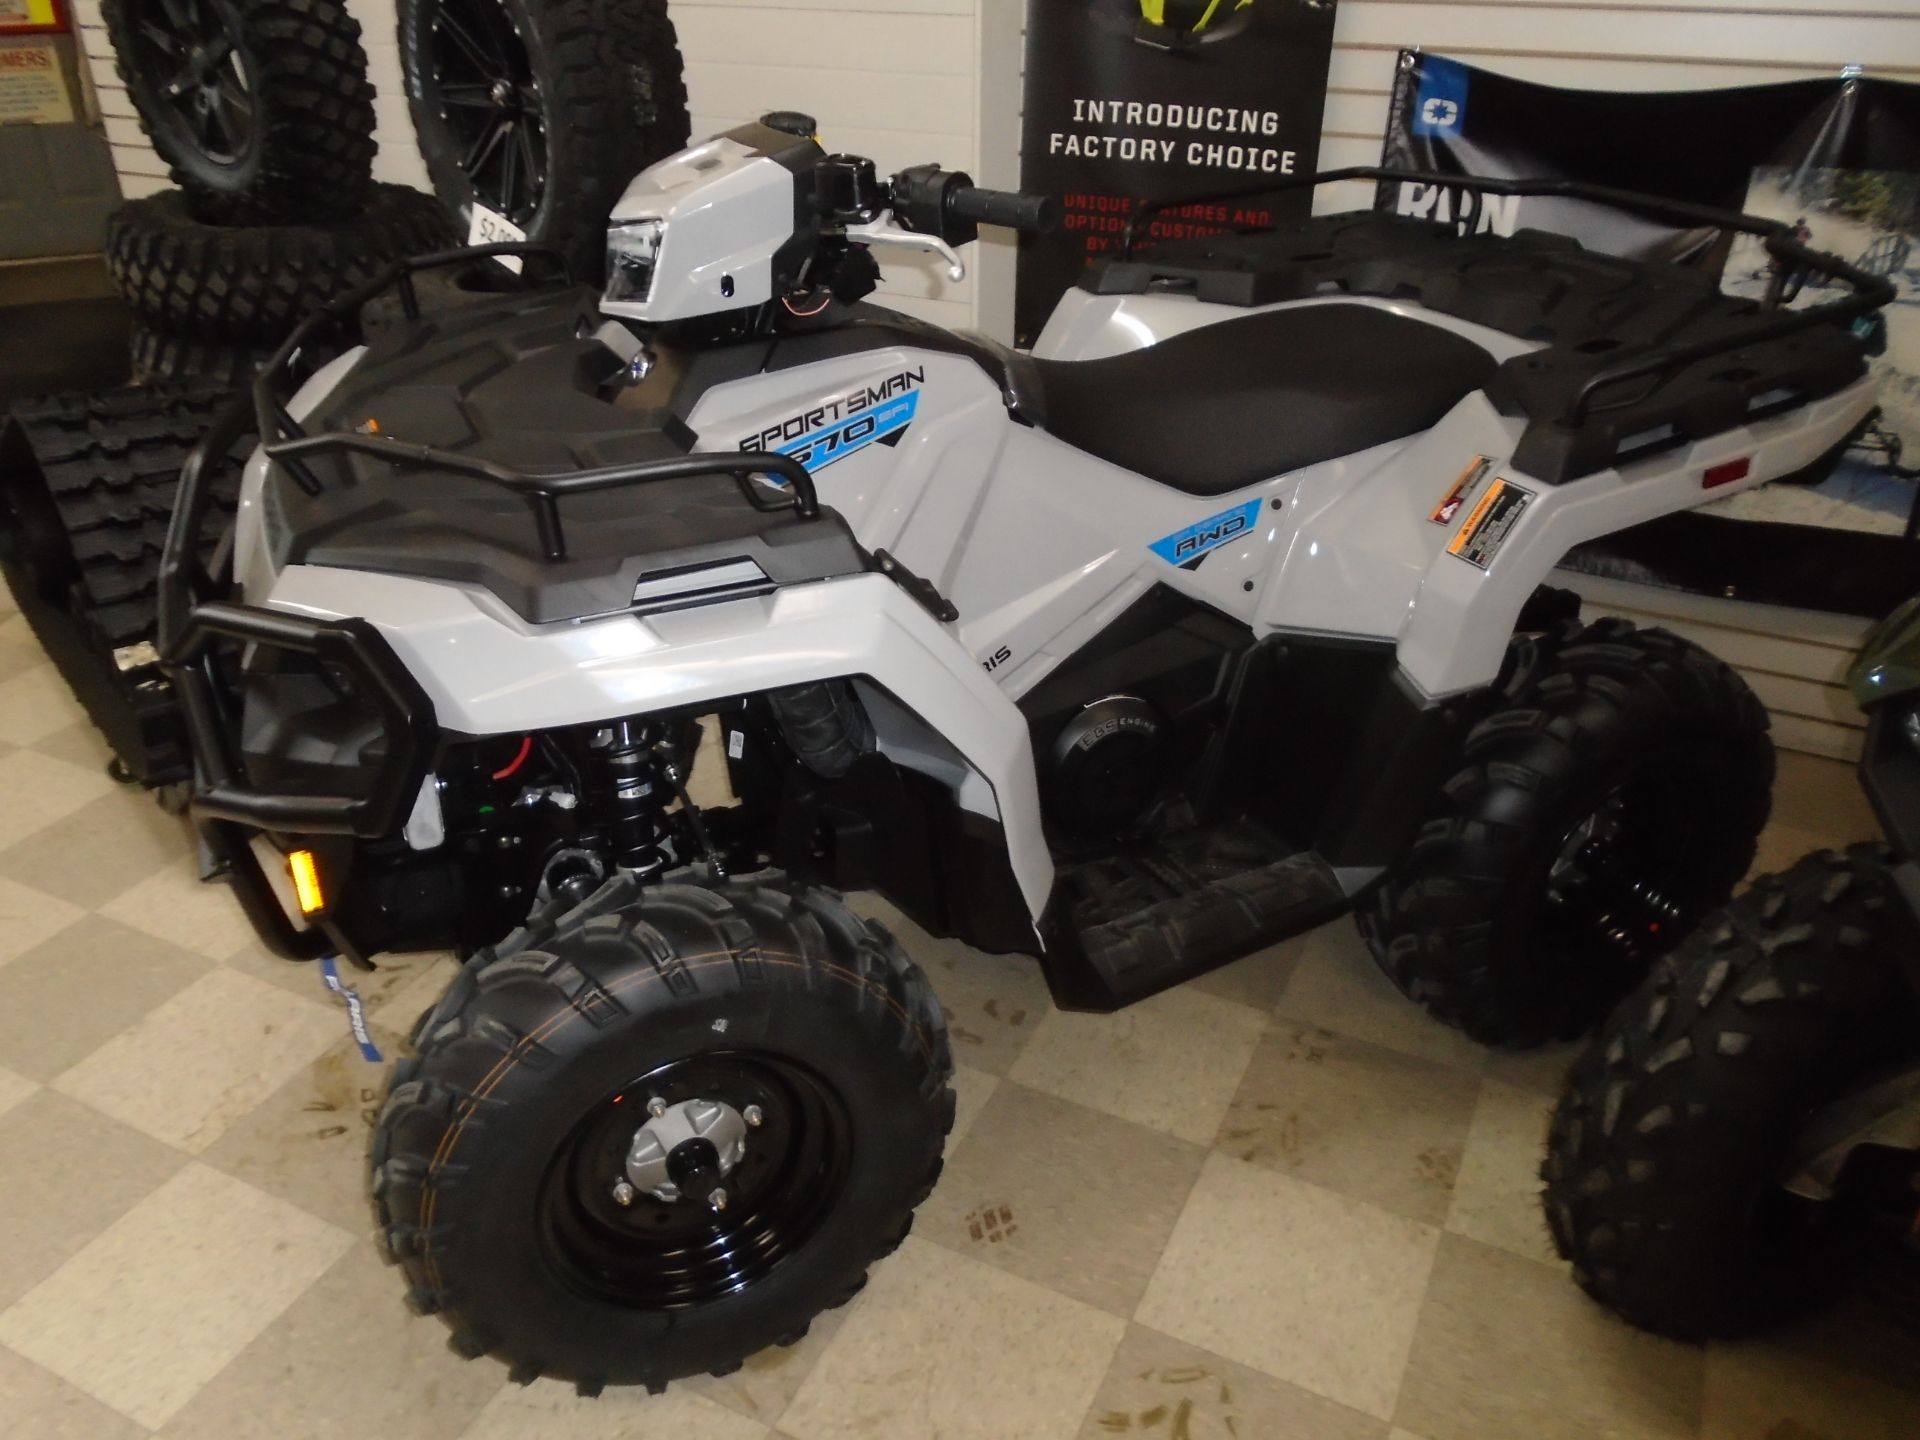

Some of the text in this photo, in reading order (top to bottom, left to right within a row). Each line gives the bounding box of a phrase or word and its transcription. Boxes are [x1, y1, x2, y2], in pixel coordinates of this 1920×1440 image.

[1073, 99, 1280, 136] INTRODUCING
[1050, 133, 1297, 175] FACTORY CHOICE
[1063, 194, 1131, 213] UNIQUE
[1233, 210, 1271, 226] AND
[1087, 236, 1109, 252] BY
[738, 364, 926, 453] SPORTSMAN
[1176, 515, 1246, 558] AWD
